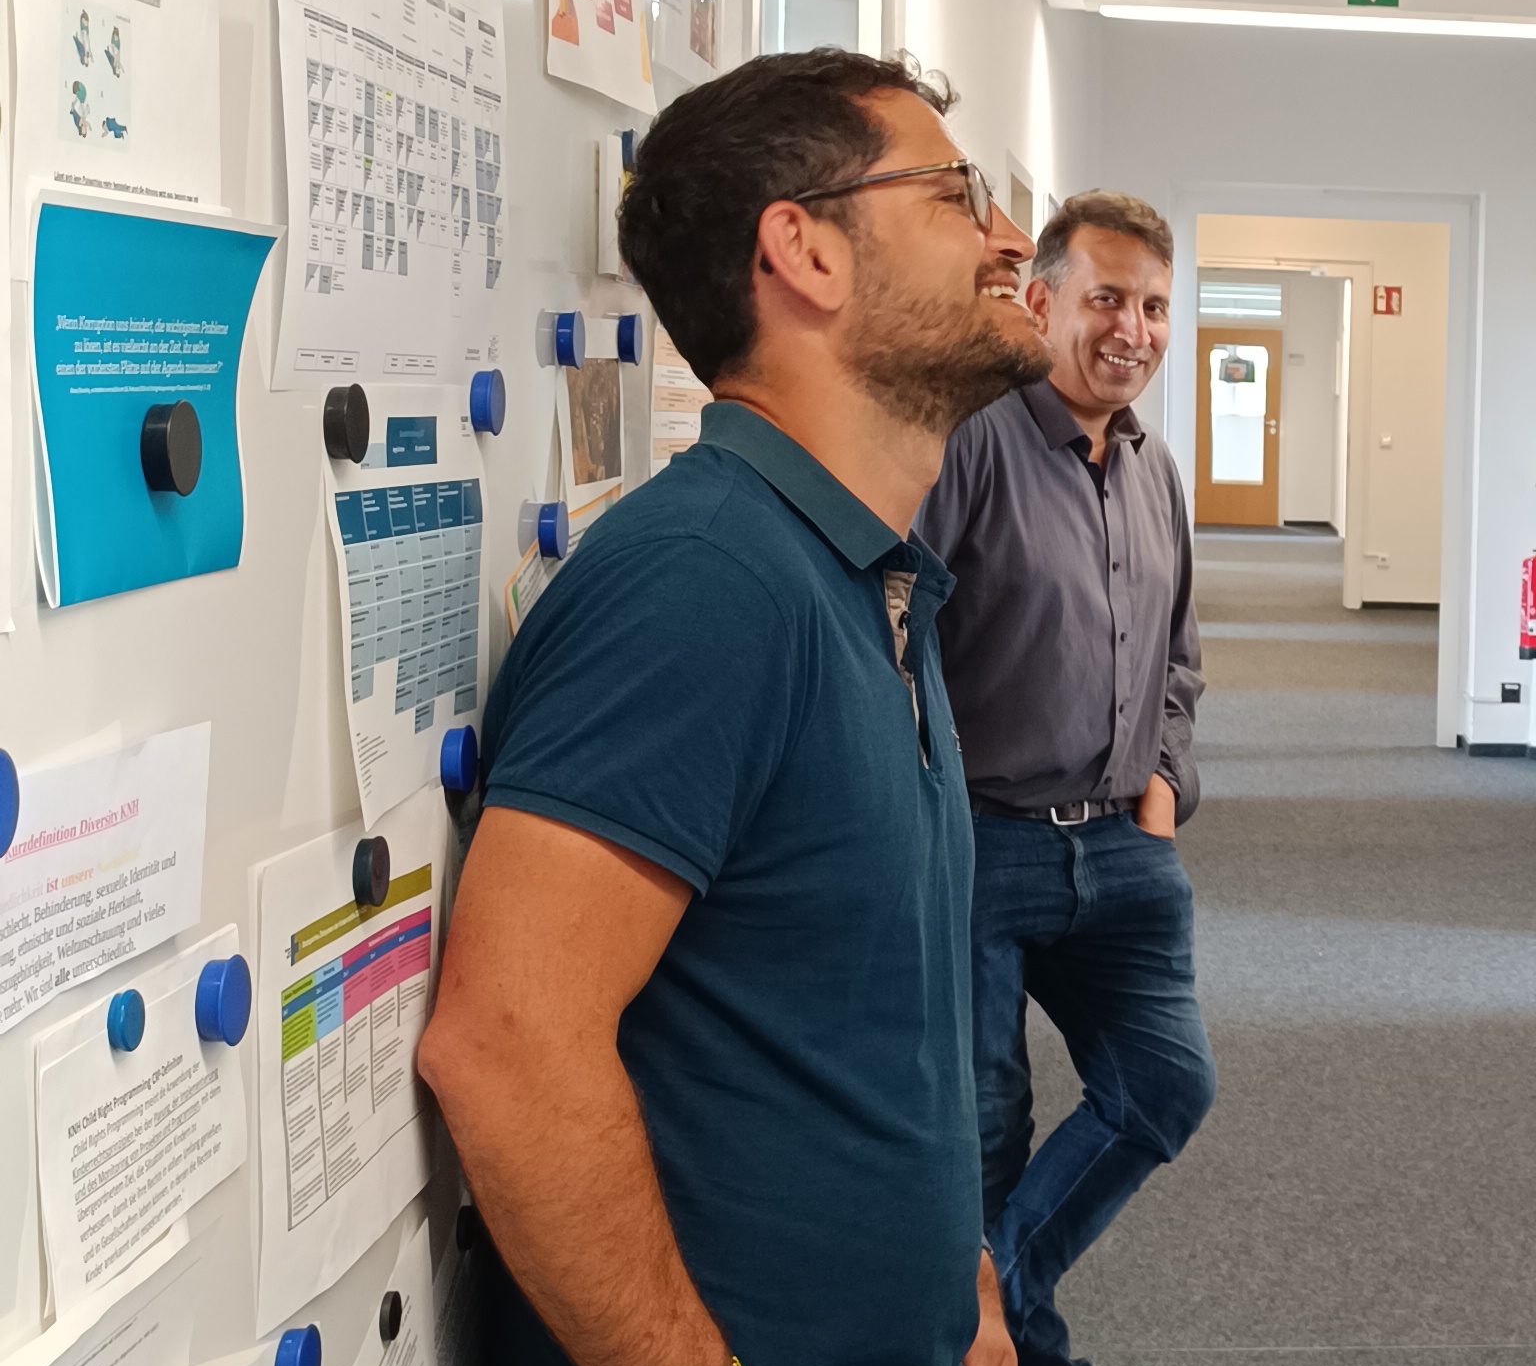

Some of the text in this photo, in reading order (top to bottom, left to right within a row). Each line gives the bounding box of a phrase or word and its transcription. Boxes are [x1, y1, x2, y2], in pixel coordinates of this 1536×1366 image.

[80, 809, 118, 835] Diversity
[120, 799, 139, 819] KNH
[46, 877, 58, 893] ist
[62, 868, 94, 888] unsere
[56, 917, 73, 937] und
[76, 905, 106, 930] soziale
[127, 910, 141, 930] und
[144, 902, 165, 922] vieles
[24, 986, 39, 1004] Wir
[40, 974, 53, 996] sind
[55, 967, 70, 987] alle
